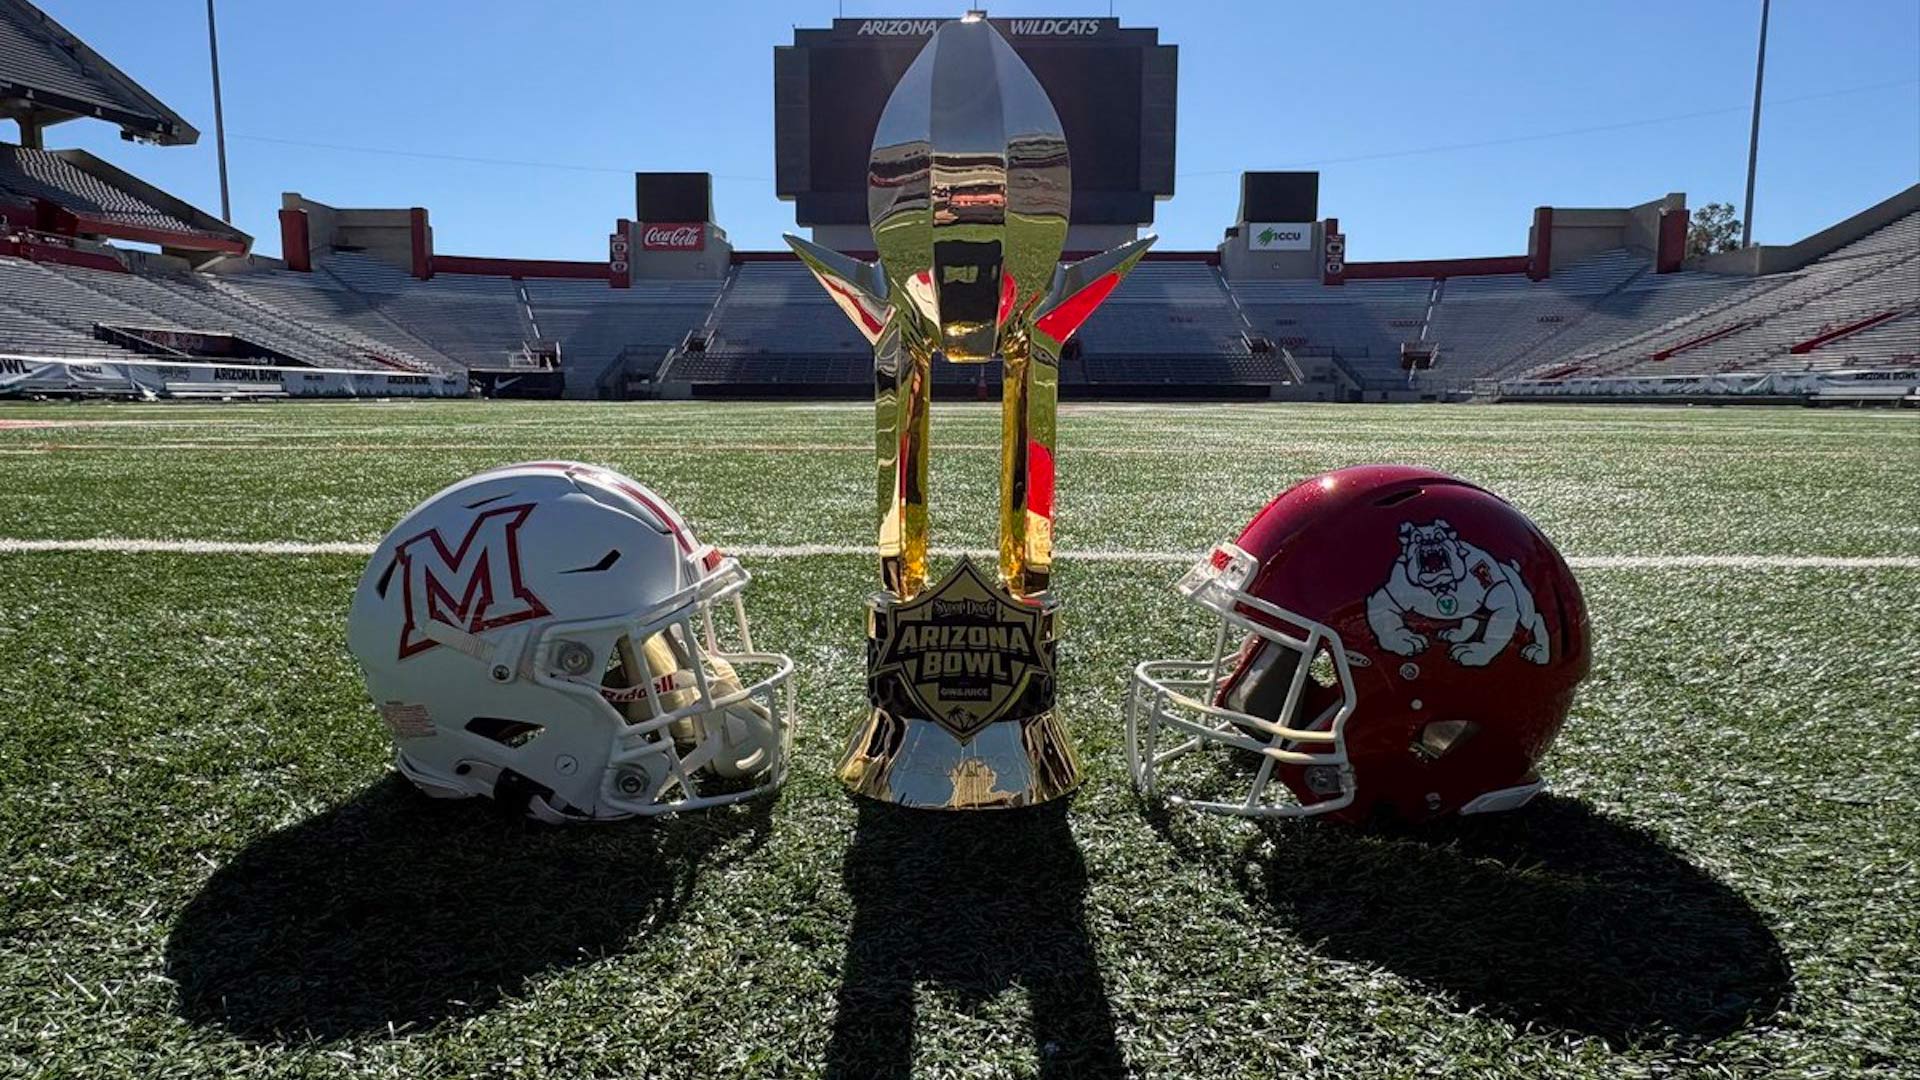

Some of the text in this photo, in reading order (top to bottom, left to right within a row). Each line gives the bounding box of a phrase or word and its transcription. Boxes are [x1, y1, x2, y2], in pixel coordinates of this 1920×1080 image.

[858, 20, 1099, 35] ARIZONA WILDCATS
[644, 227, 700, 246] Coca-Cola
[0, 359, 32, 374] WL
[214, 367, 284, 382] ARIZONA BOWL
[898, 625, 1031, 656] ARIZONA
[923, 651, 1008, 679] BOWL
